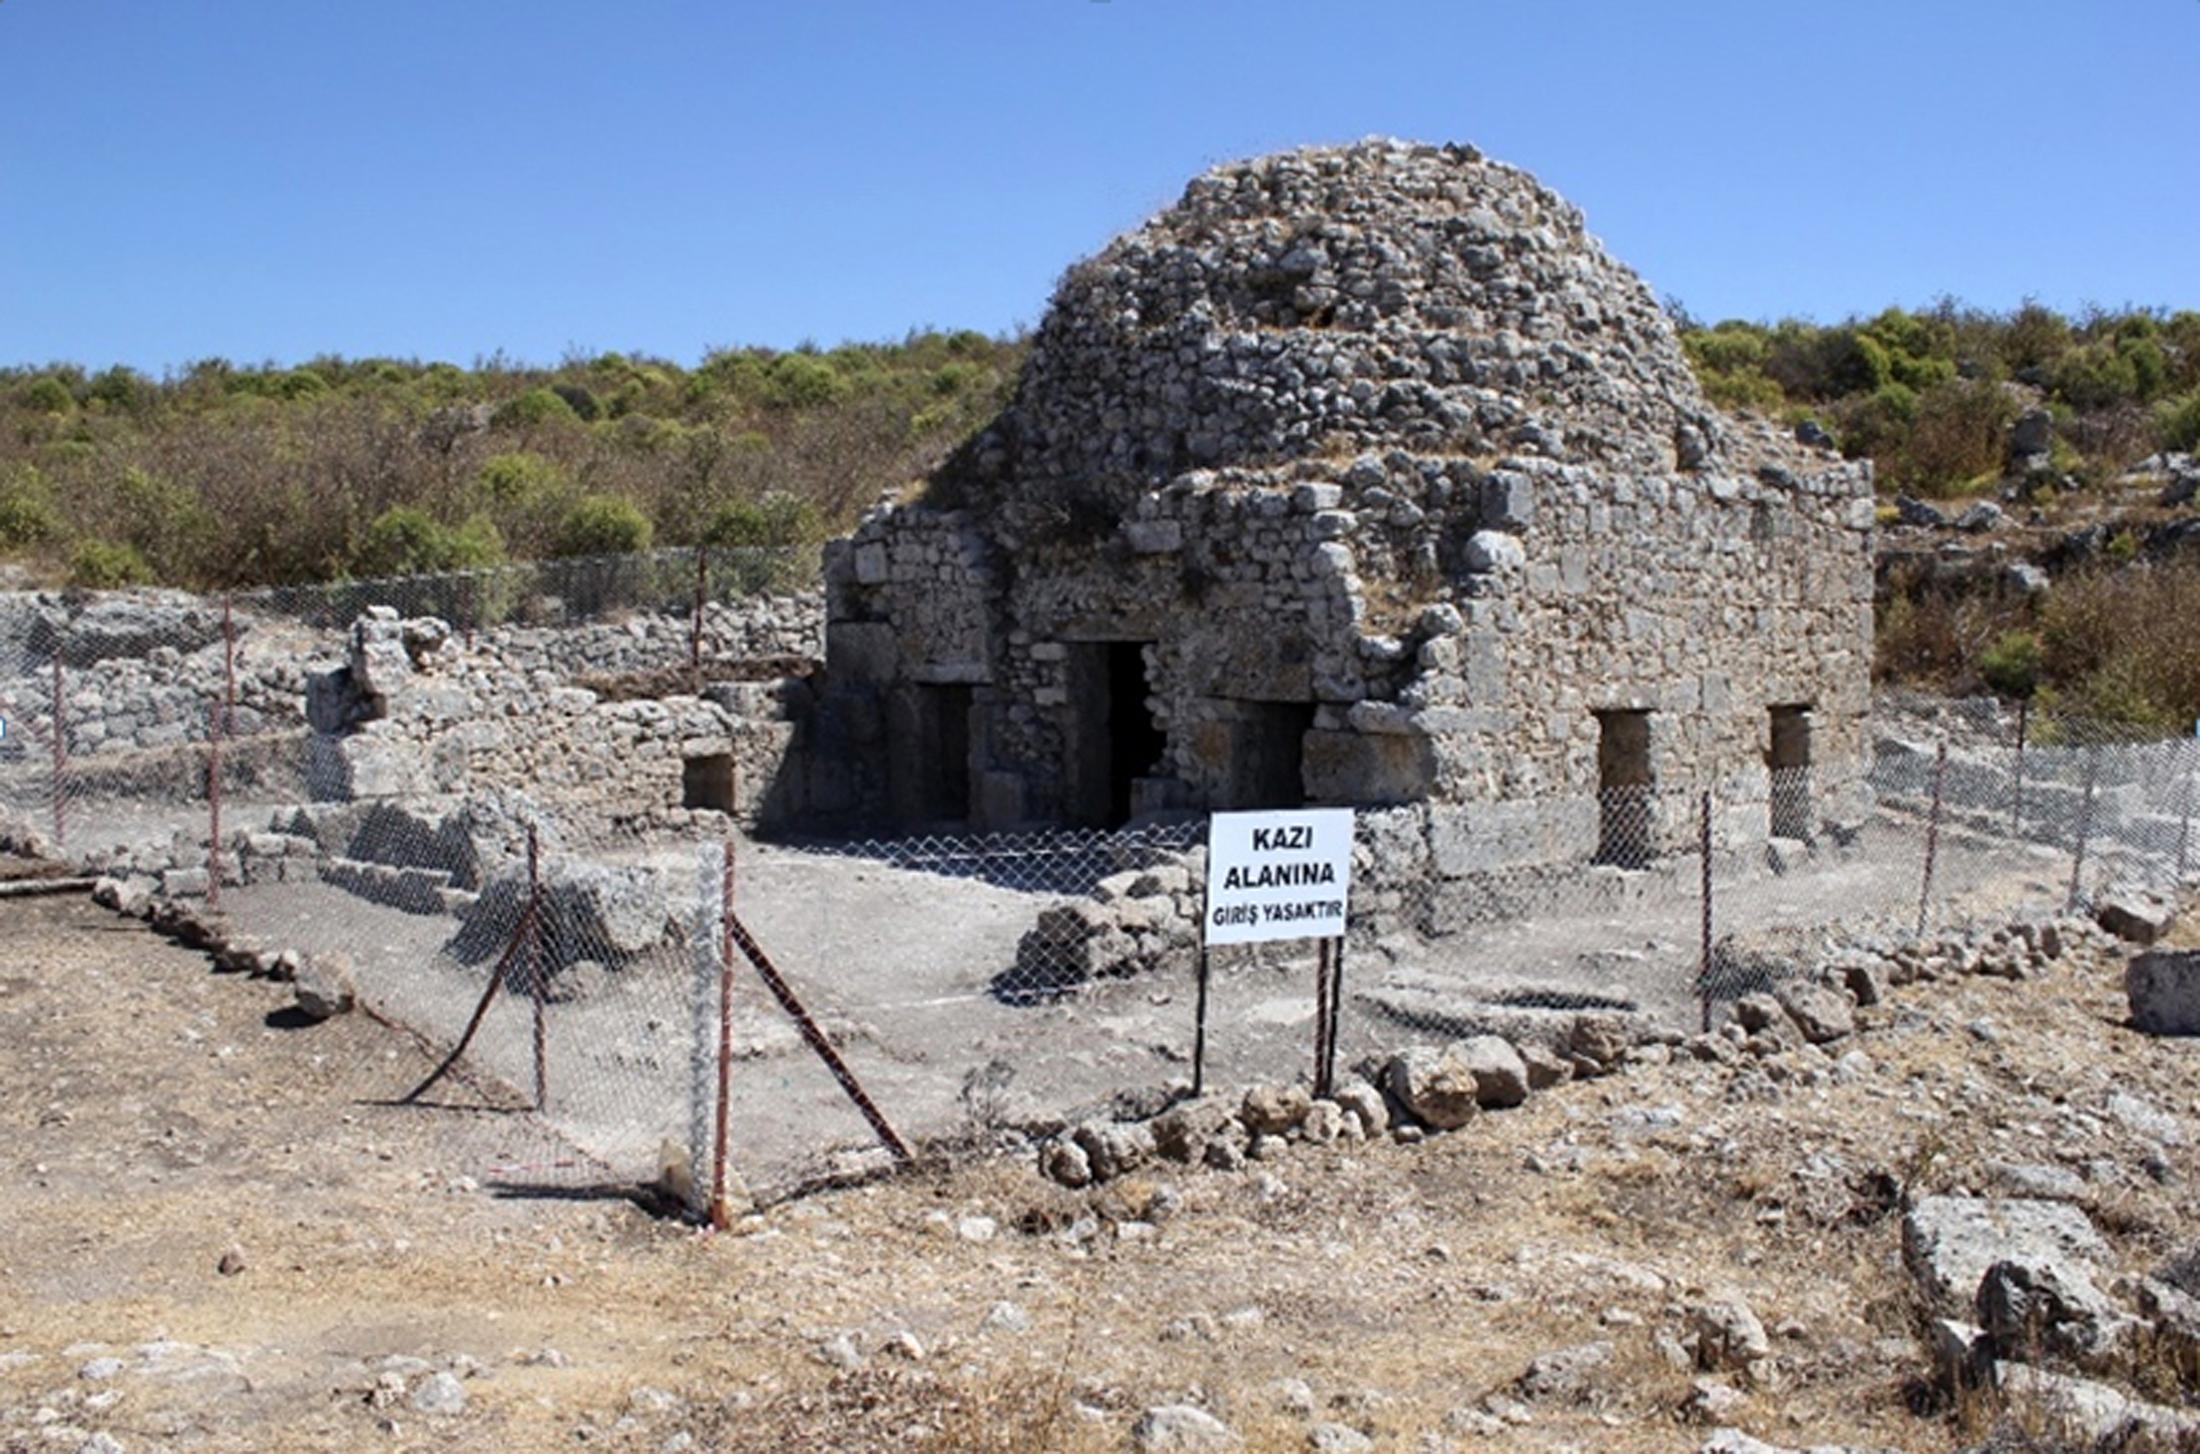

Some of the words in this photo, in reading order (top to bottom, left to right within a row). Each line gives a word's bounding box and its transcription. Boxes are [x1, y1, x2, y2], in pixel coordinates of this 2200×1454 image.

[1253, 826, 1312, 851] KAZI
[1224, 862, 1335, 889] ALANINA
[1263, 900, 1343, 922] YASAKTIR
